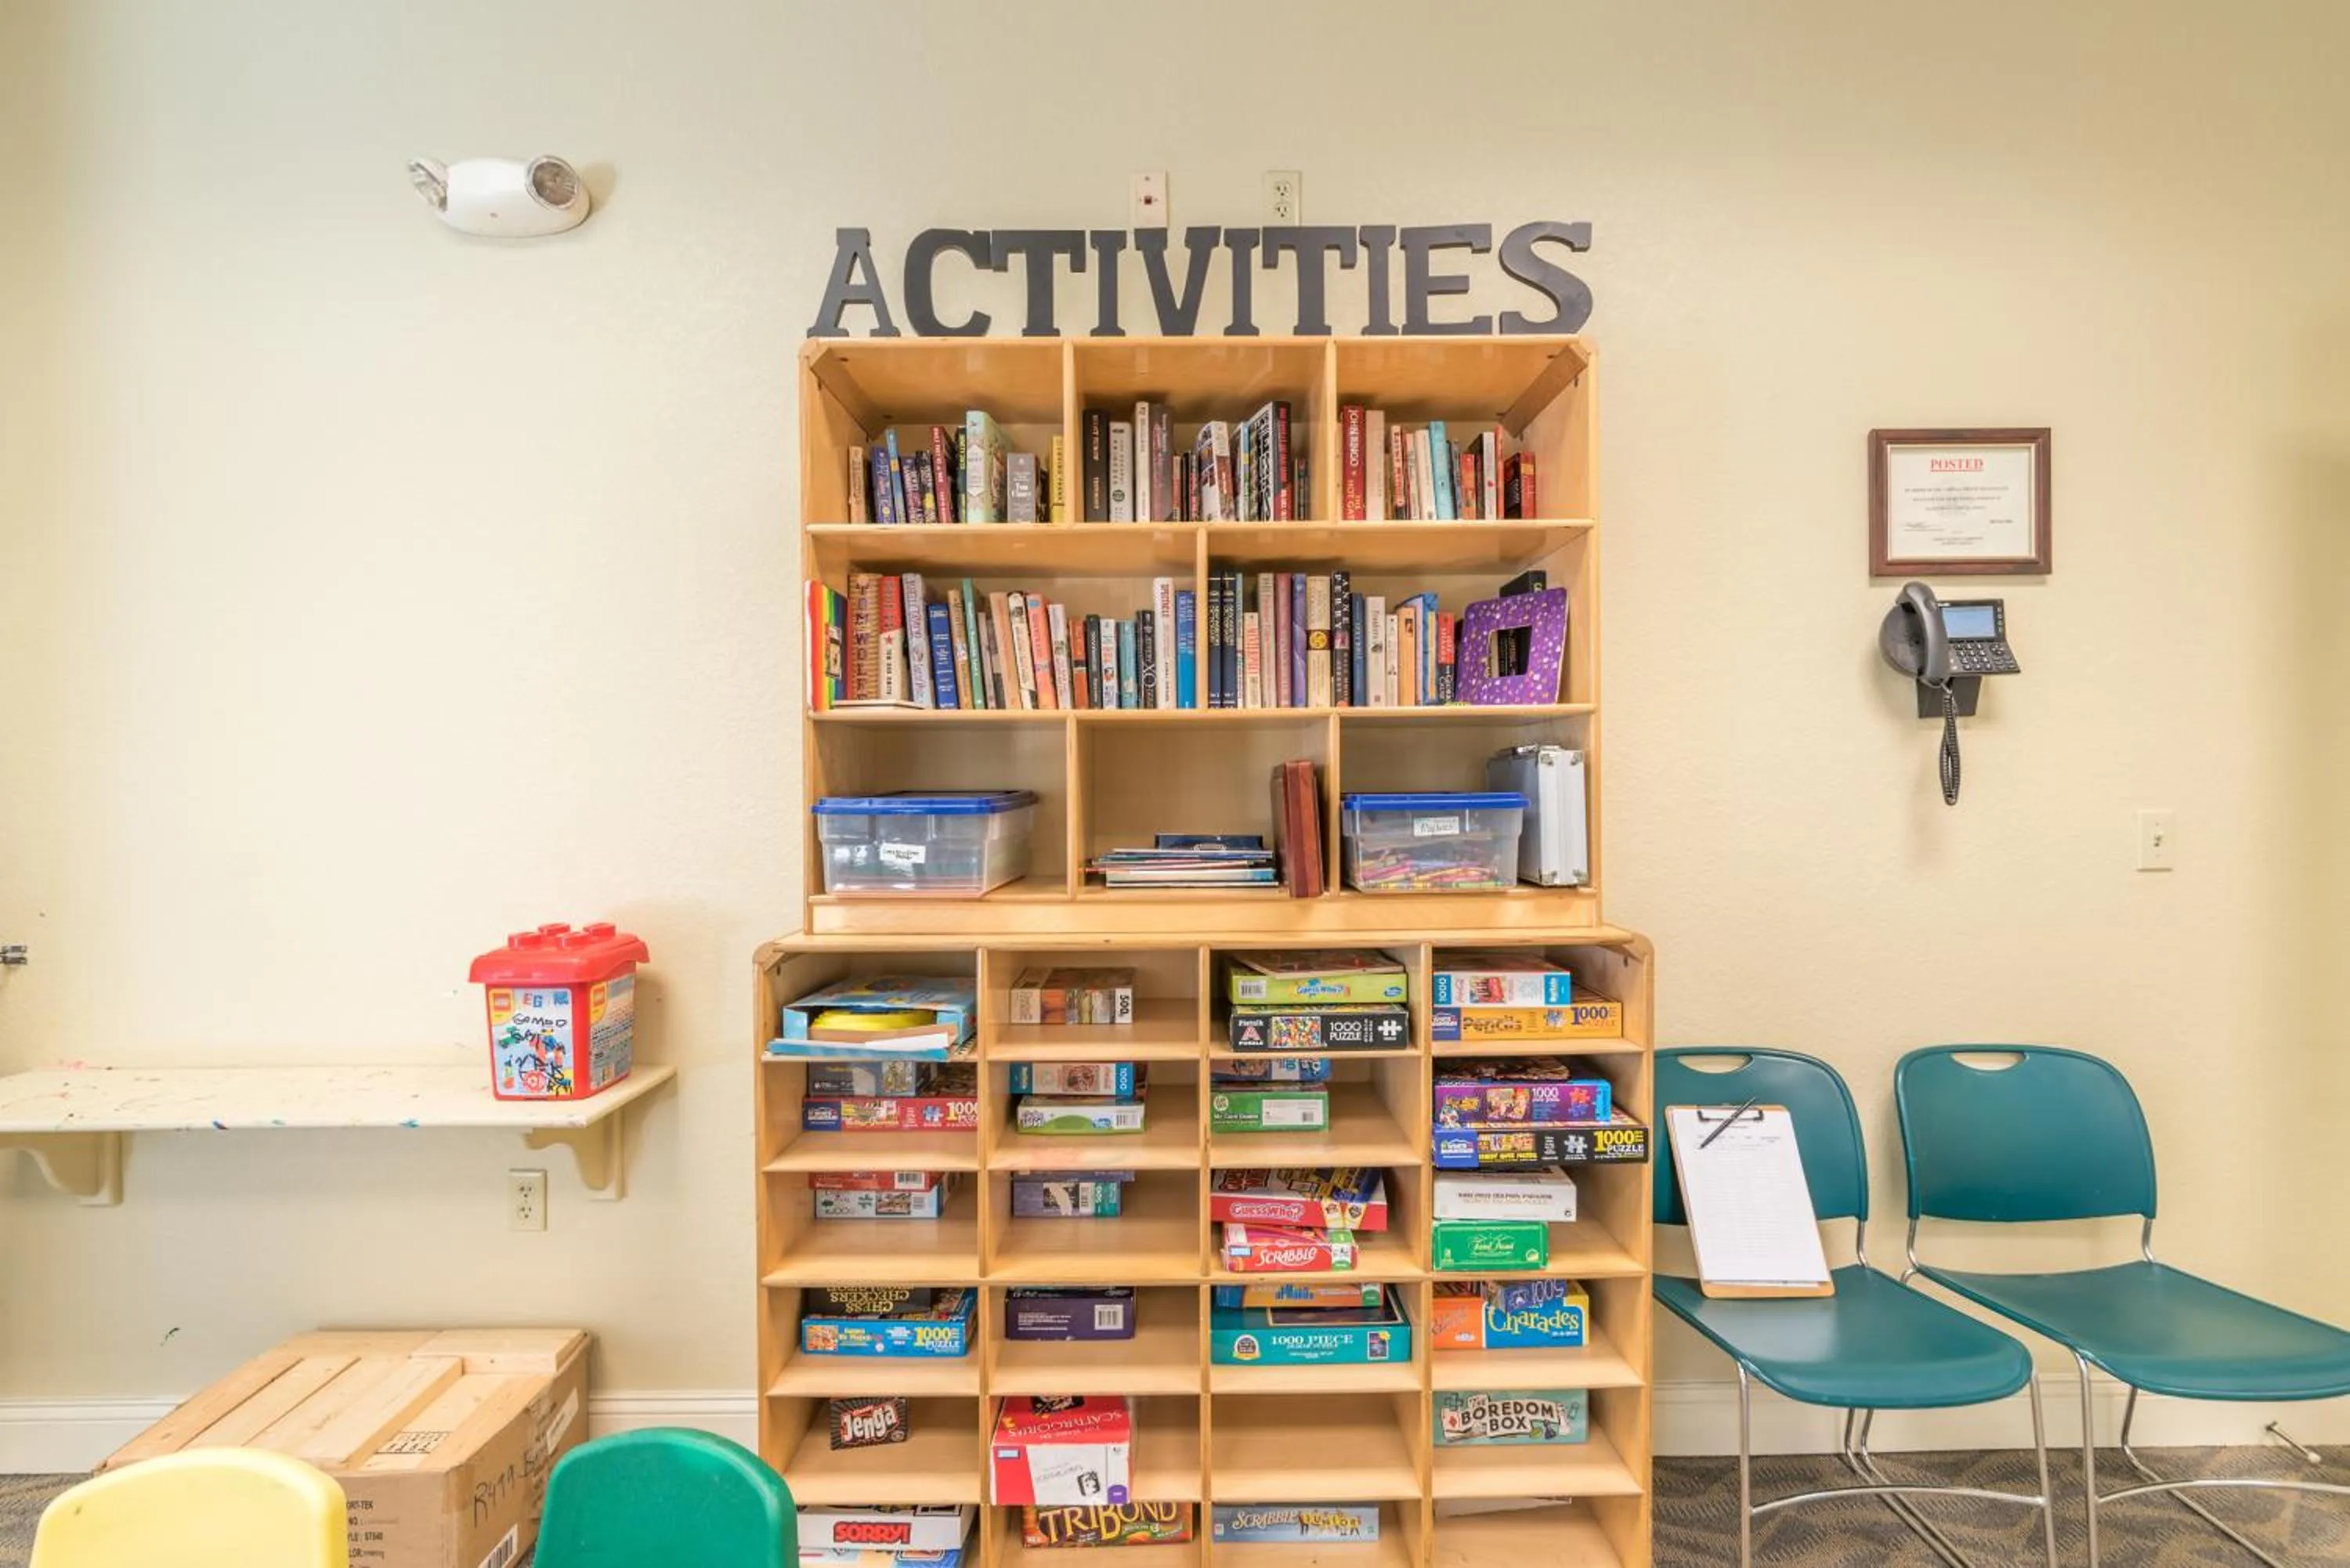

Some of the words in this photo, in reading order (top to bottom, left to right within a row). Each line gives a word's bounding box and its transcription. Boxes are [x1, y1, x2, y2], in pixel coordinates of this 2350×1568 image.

[807, 220, 1593, 337] ACTIVITIES
[1929, 458, 1984, 471] POSTED
[855, 583, 870, 626] TOM
[1334, 573, 1343, 630] PERRY
[1439, 977, 1448, 1002] 1000
[1571, 1006, 1609, 1025] 1000
[1329, 1021, 1361, 1031] 1000
[1329, 1032, 1362, 1041] PUZZLE
[1119, 1068, 1128, 1090] 1000
[1532, 1087, 1559, 1097] 1000
[1593, 1131, 1635, 1153] 1000
[1607, 1144, 1644, 1153] PUZZLE
[1256, 1247, 1317, 1266] SCRABBLE
[830, 1291, 910, 1302] CHECKERS
[845, 1302, 894, 1313] CHESS
[1488, 1305, 1579, 1334] Charades
[913, 1328, 950, 1347] 1000
[925, 1340, 960, 1349] PUZZLE
[1271, 1335, 1304, 1345] 1000
[1307, 1334, 1354, 1345] PIECE
[840, 1403, 898, 1442] Jenga
[1461, 1401, 1554, 1425] BOREDOM
[1489, 1416, 1527, 1432] BOX
[1039, 1502, 1177, 1544] TRIBOND
[833, 1521, 912, 1545] SORRY!
